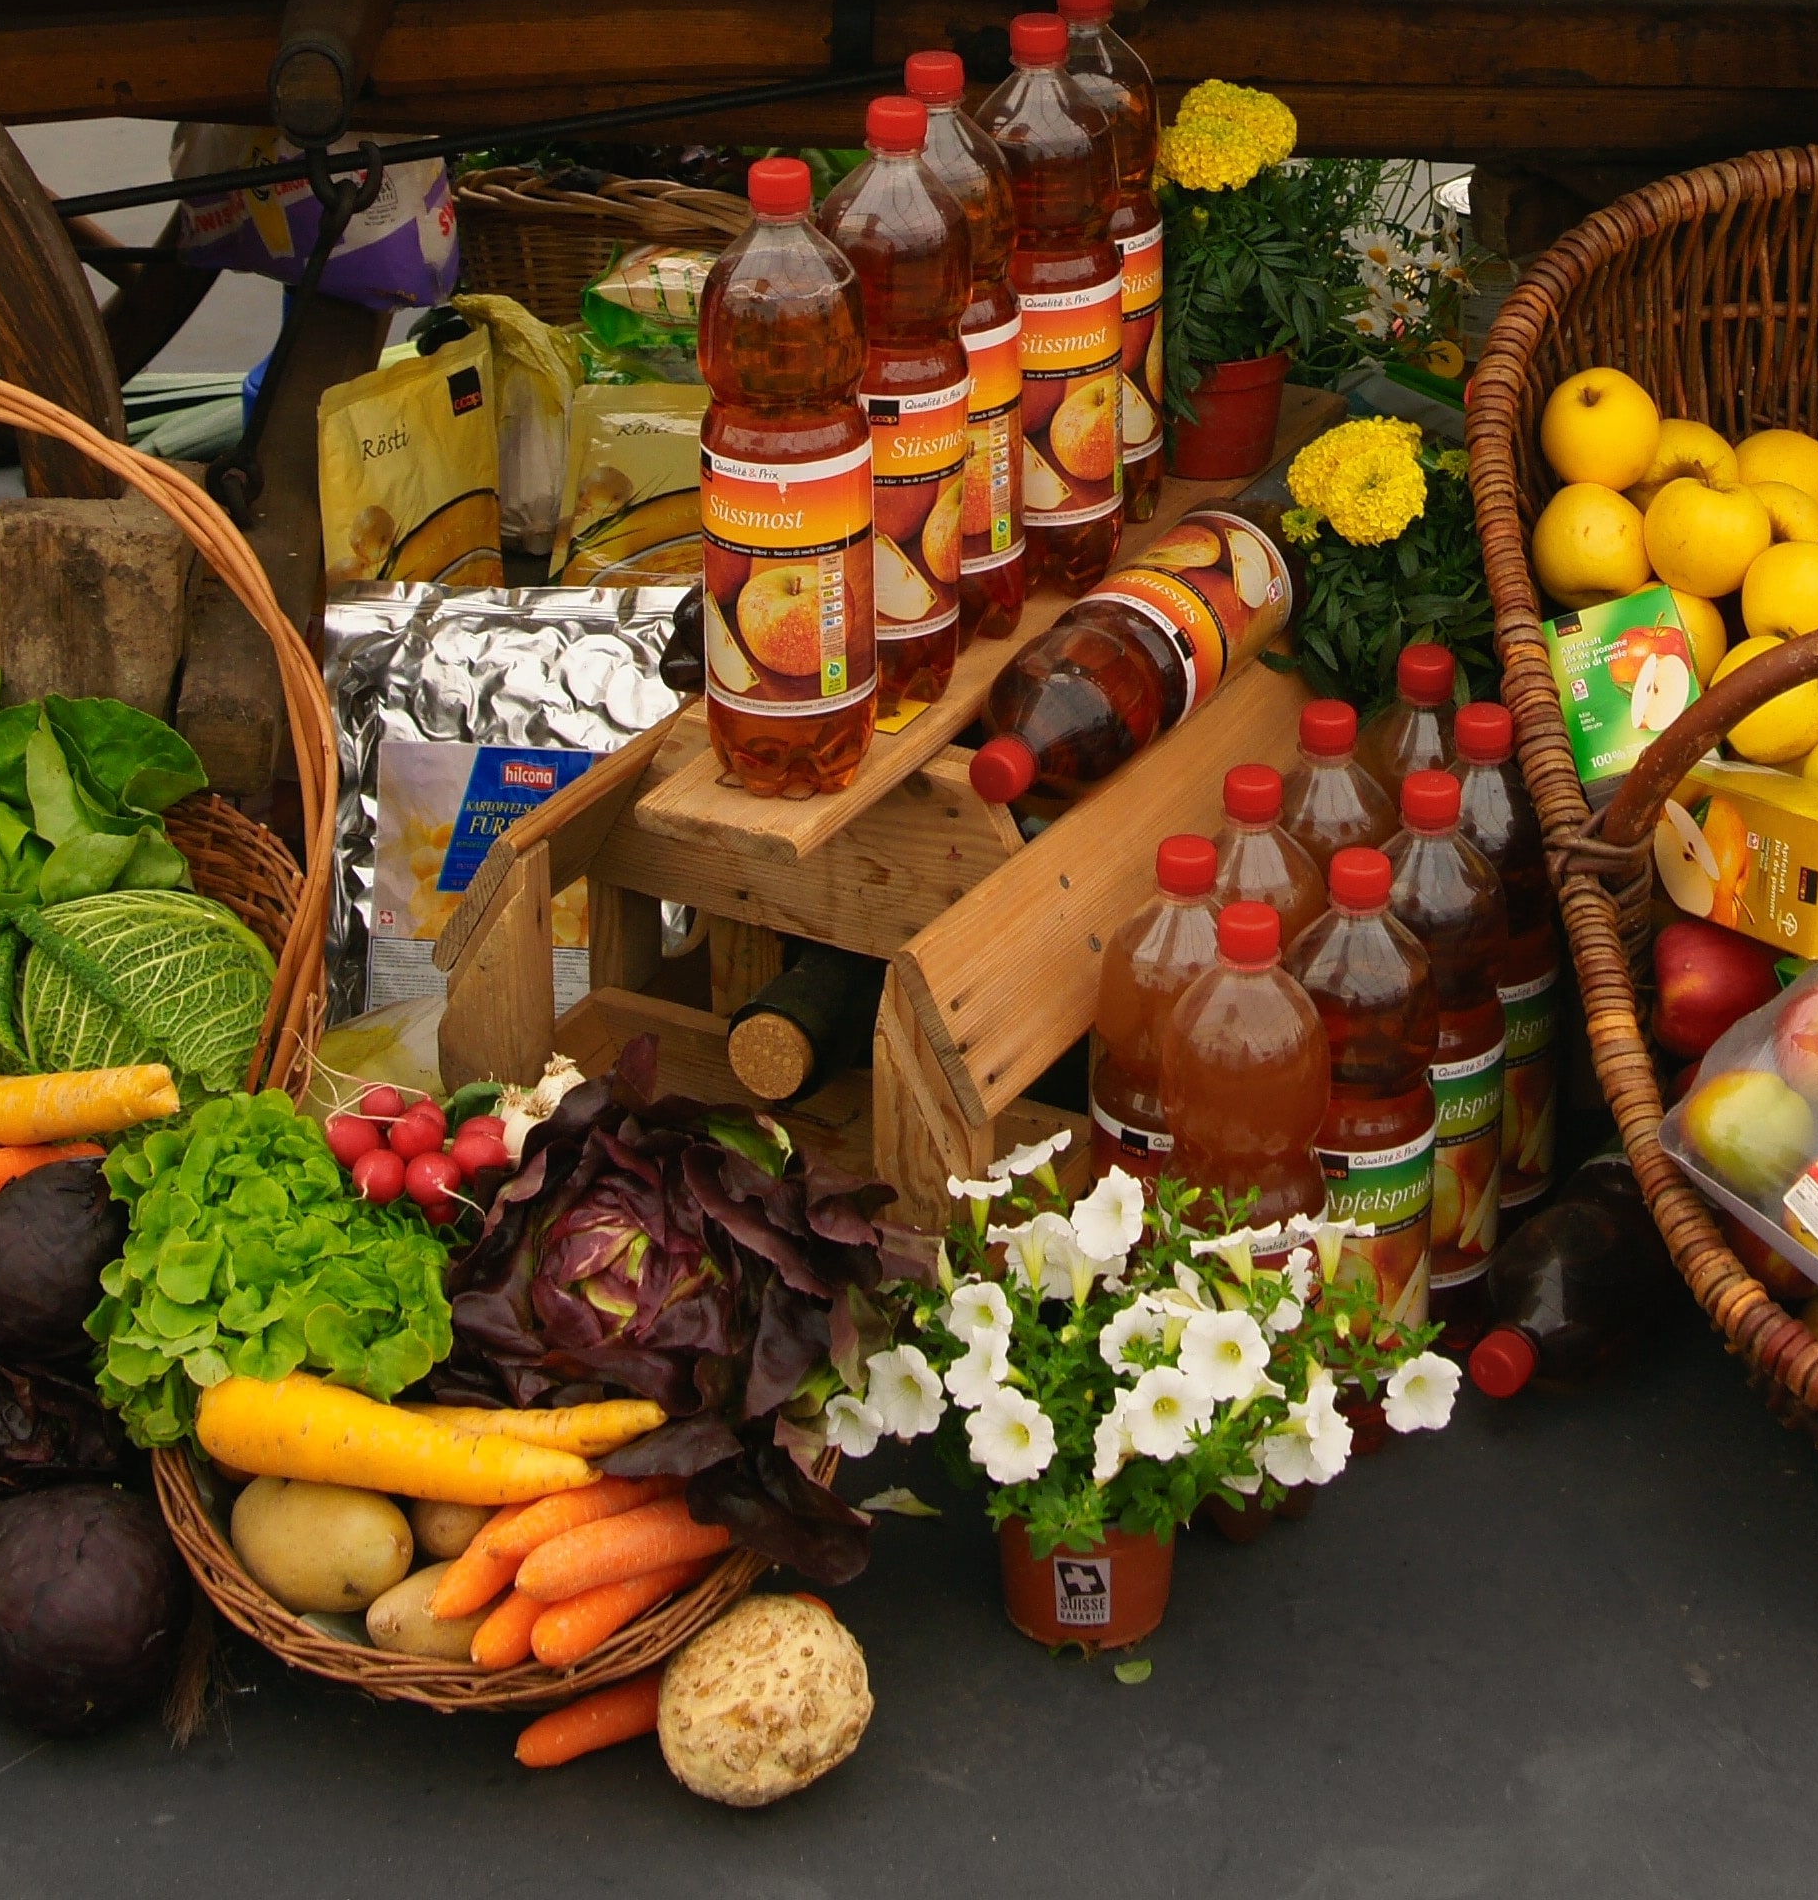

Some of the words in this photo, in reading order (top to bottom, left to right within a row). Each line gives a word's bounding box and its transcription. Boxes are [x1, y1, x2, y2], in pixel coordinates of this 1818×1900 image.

[1024, 296, 1063, 310] Qualité
[1065, 297, 1073, 307] &
[1074, 295, 1090, 307] Prix
[454, 393, 480, 410] coop
[904, 395, 941, 411] Qualité
[941, 393, 949, 404] &
[362, 423, 411, 462] Rösti
[891, 427, 964, 460] Süssmos
[714, 459, 748, 478] Qualité
[748, 469, 757, 479] &
[758, 468, 779, 480] Prix
[710, 493, 805, 530] Süssmost
[1114, 574, 1201, 625] Süssmost
[1561, 637, 1602, 655] Apfelsaft
[1563, 655, 1577, 667] jus
[1578, 651, 1590, 663] de
[1592, 639, 1629, 657] pomme
[1592, 657, 1603, 670] di
[1603, 649, 1628, 666] mele
[1590, 751, 1623, 769] 100%
[504, 765, 554, 785] hilcona
[469, 811, 504, 835] FÜR
[1438, 1062, 1475, 1079] Qualité
[1353, 1153, 1394, 1167] Qualité
[1394, 1150, 1402, 1160] &
[1402, 1146, 1419, 1158] Prix
[1249, 1240, 1289, 1256] Qualité
[1060, 1596, 1106, 1611] SUISSE
